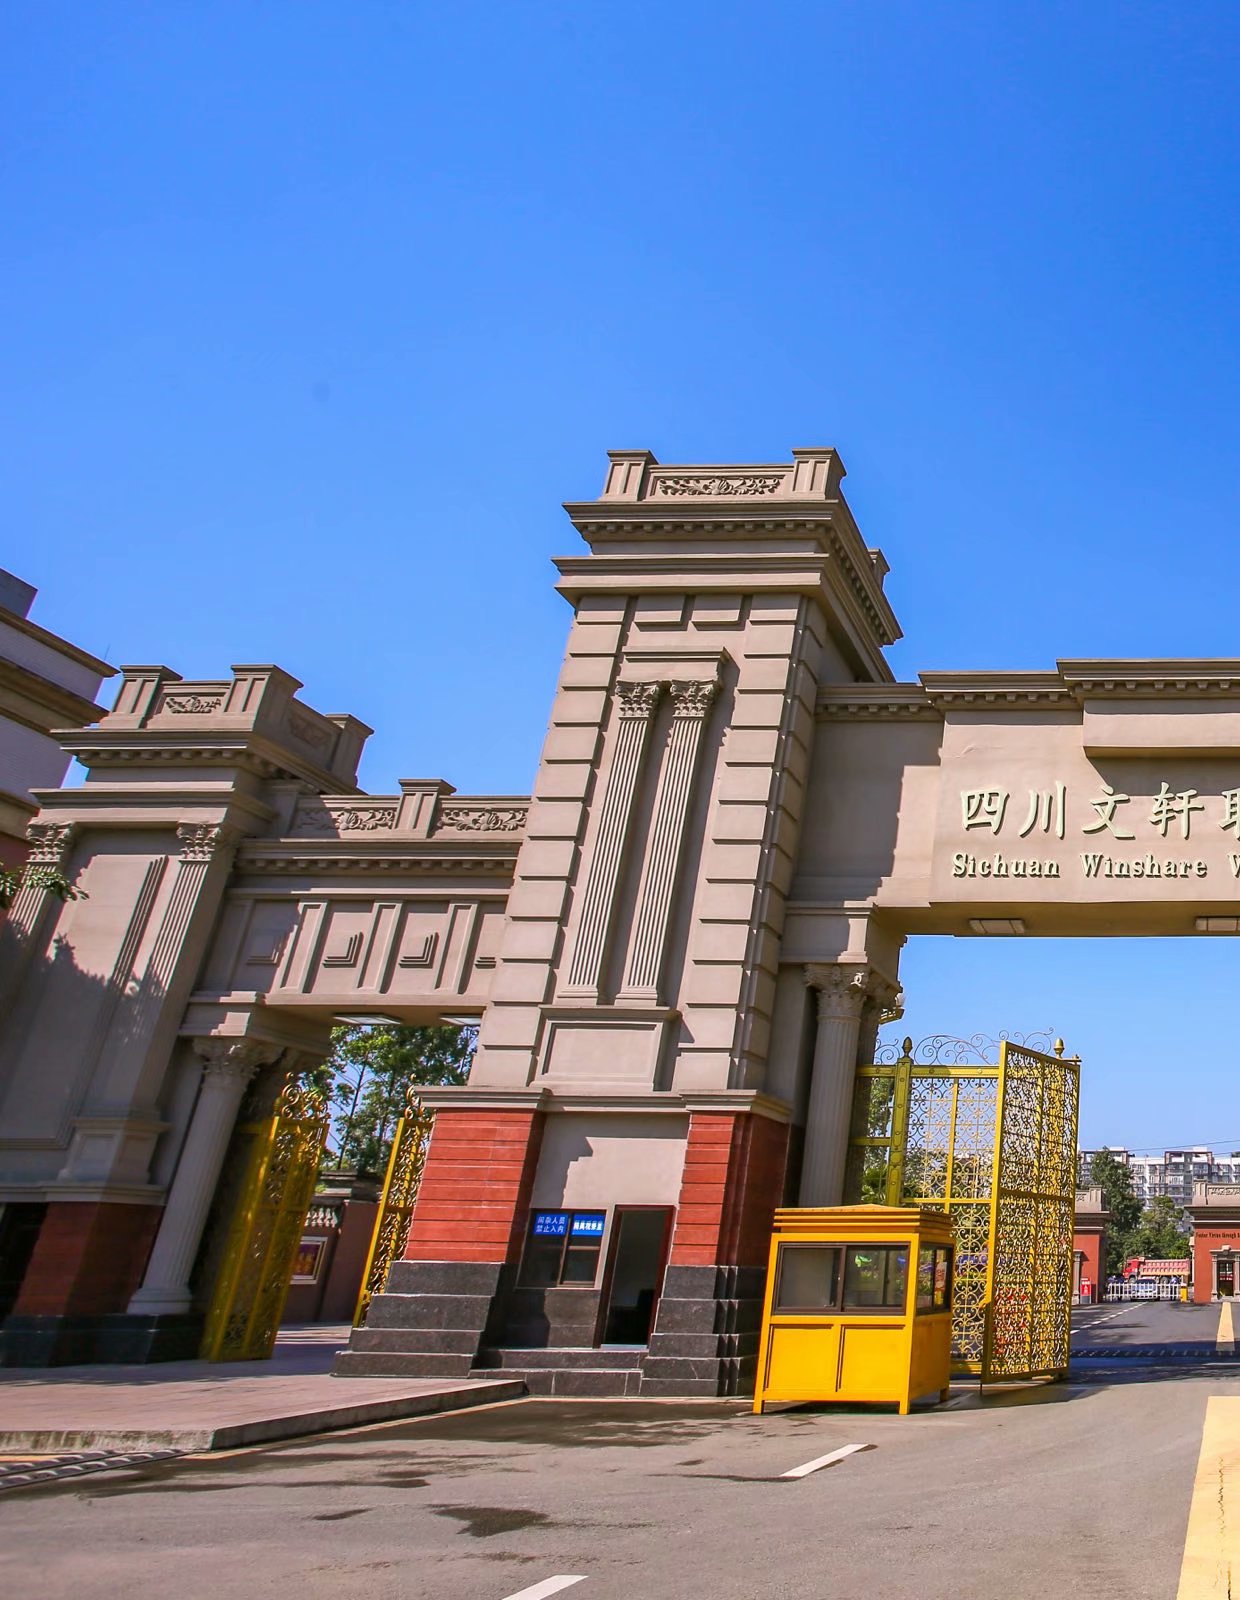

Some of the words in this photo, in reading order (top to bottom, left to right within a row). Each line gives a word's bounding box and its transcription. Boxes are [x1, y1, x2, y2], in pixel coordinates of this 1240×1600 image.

[952, 852, 1060, 878] Sichuan
[1080, 852, 1208, 878] Winshare
[535, 1225, 564, 1233] 禁止入内
